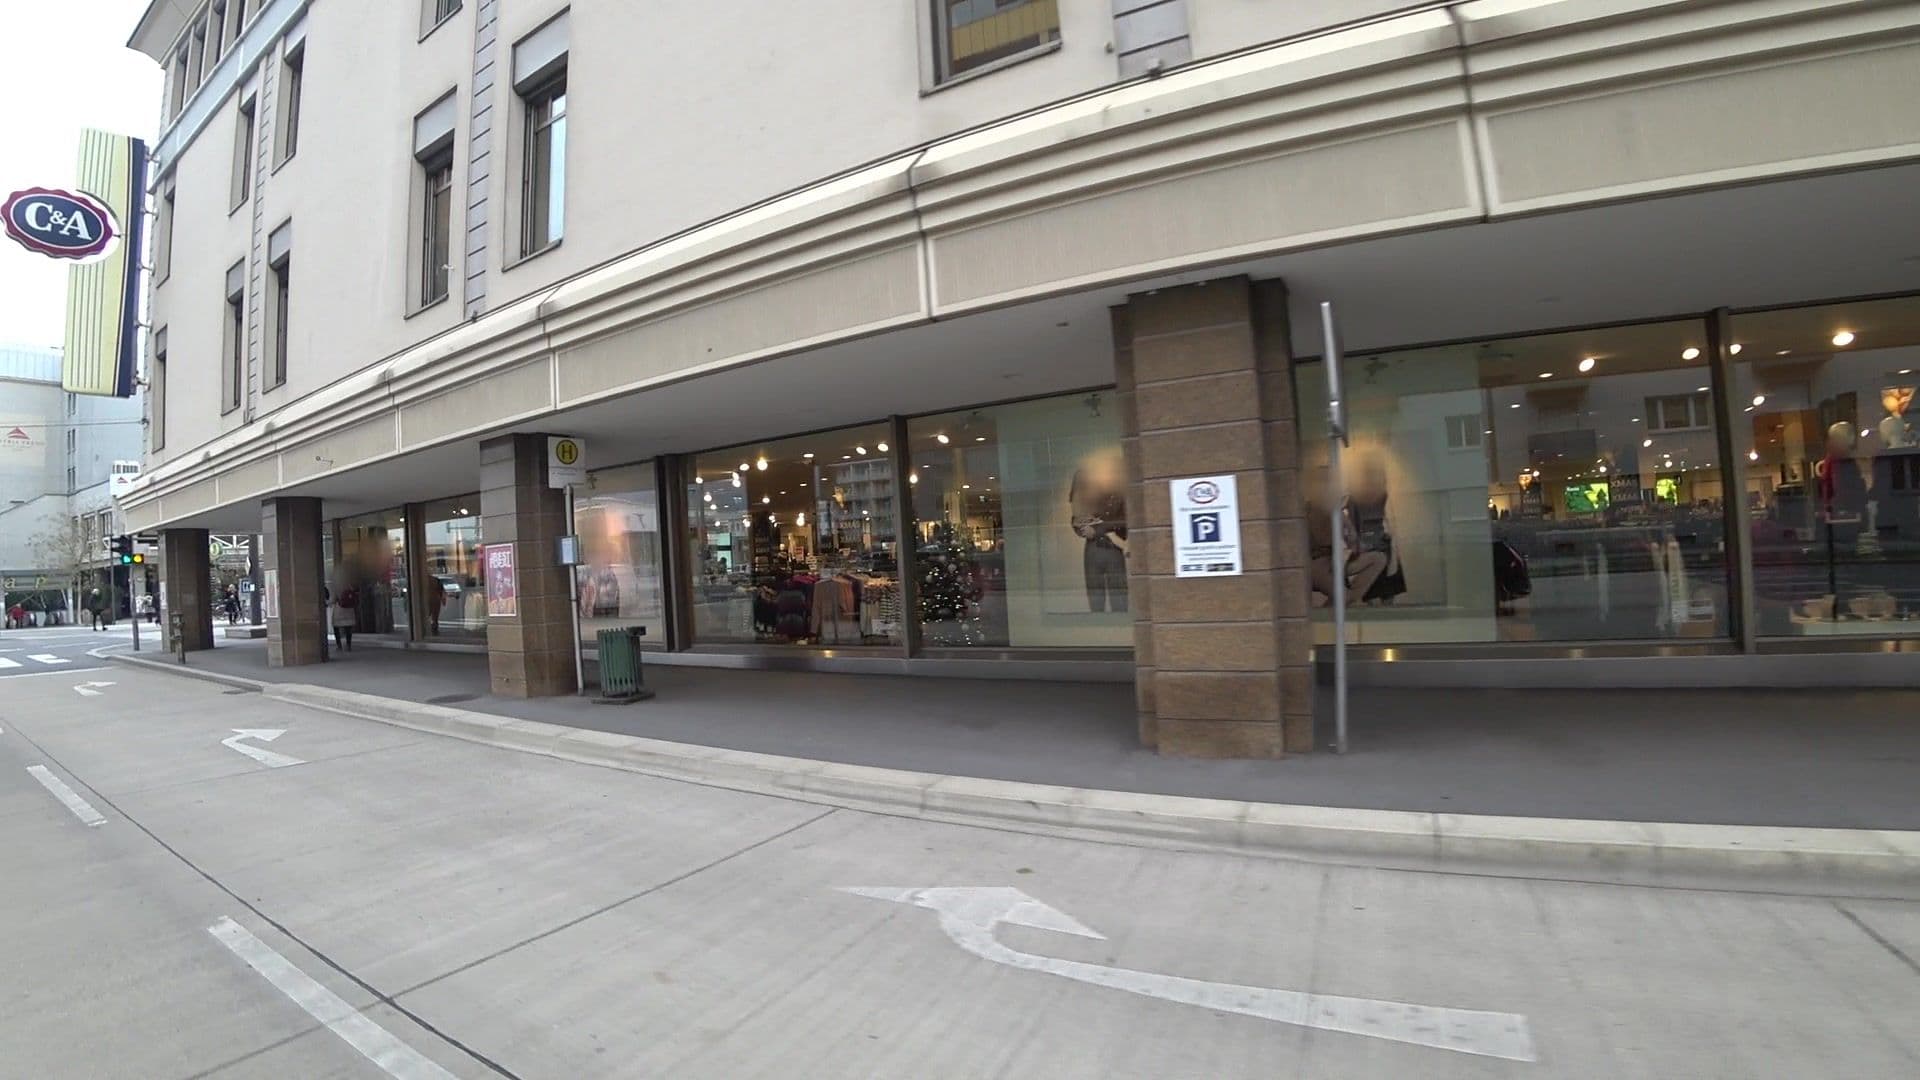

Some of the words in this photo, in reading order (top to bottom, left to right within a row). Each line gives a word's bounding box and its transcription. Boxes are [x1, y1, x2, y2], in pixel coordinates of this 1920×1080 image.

[25, 202, 92, 240] C&A
[561, 444, 573, 460] H
[1197, 522, 1215, 541] P
